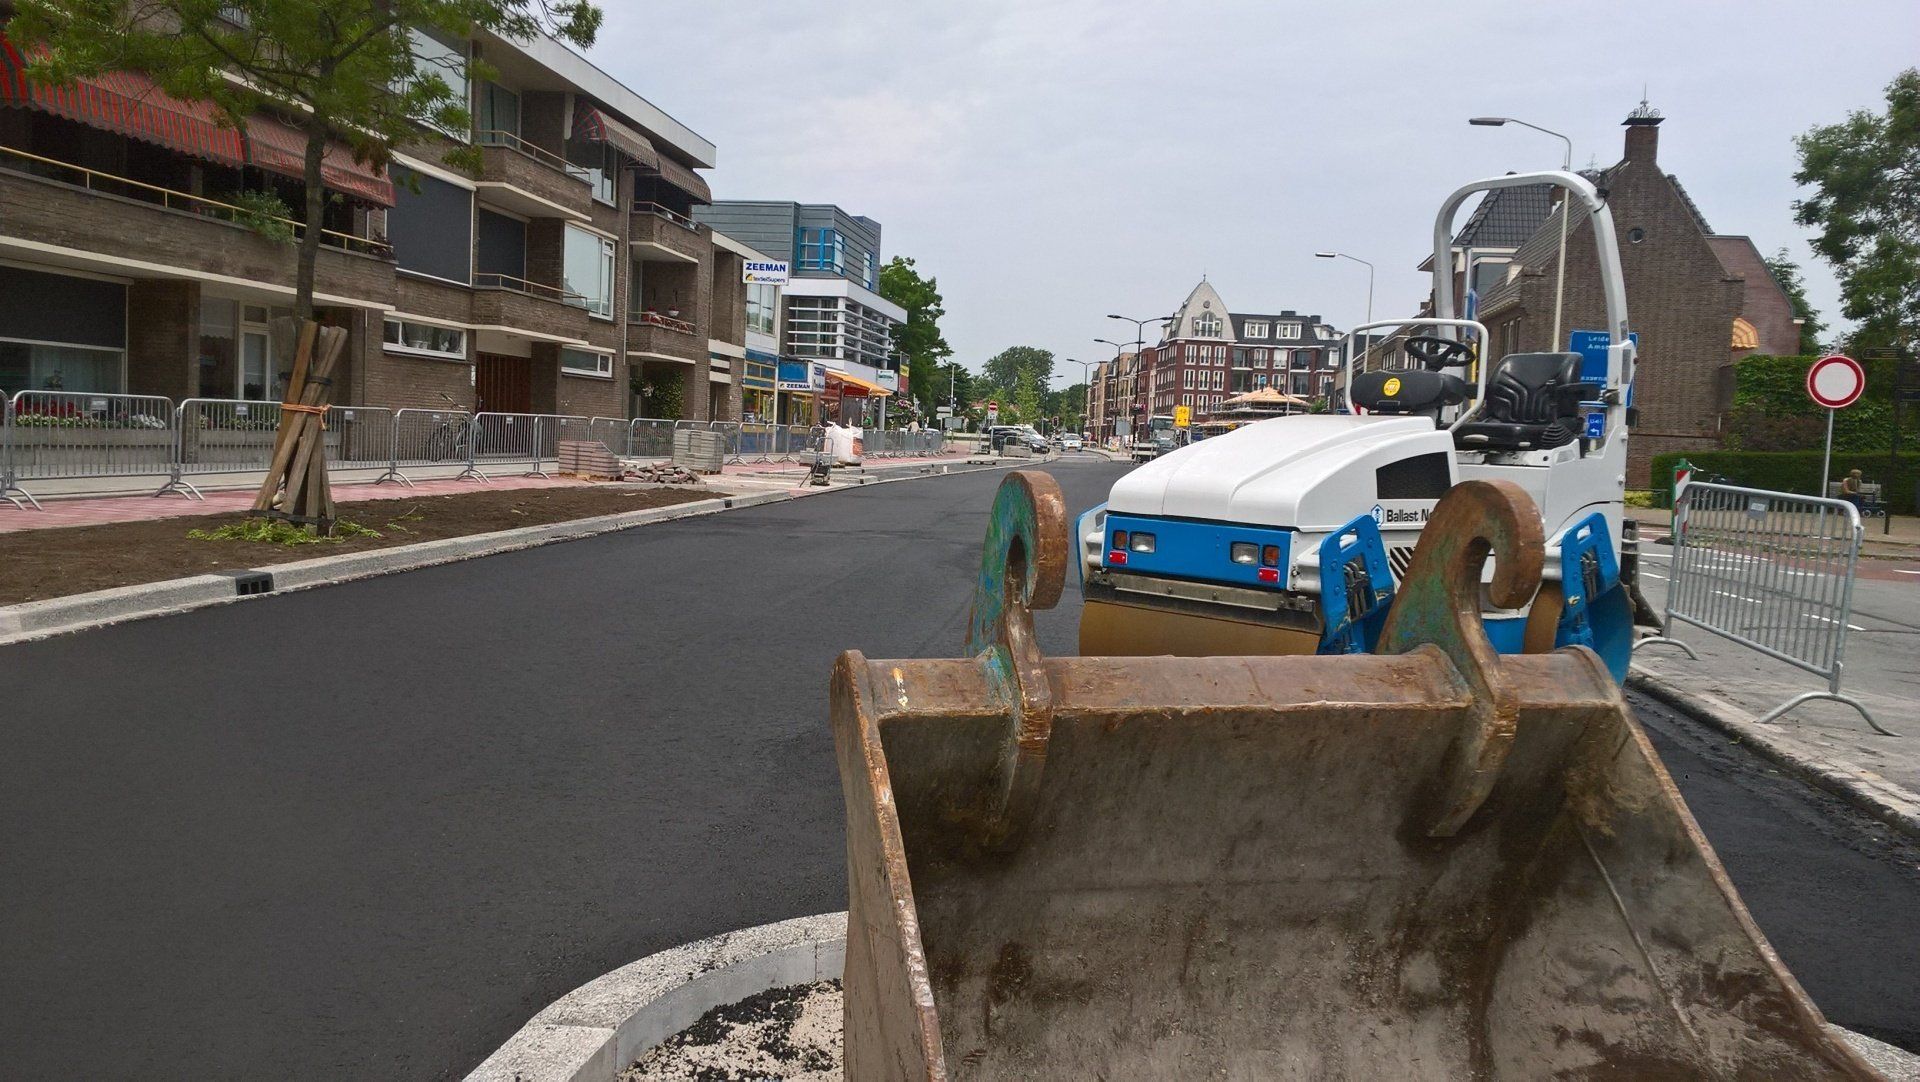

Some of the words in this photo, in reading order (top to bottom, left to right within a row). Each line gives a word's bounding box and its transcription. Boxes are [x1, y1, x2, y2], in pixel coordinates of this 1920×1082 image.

[745, 262, 786, 273] ZEEMAN
[1386, 509, 1419, 522] Ballast
[1421, 508, 1430, 521] N
